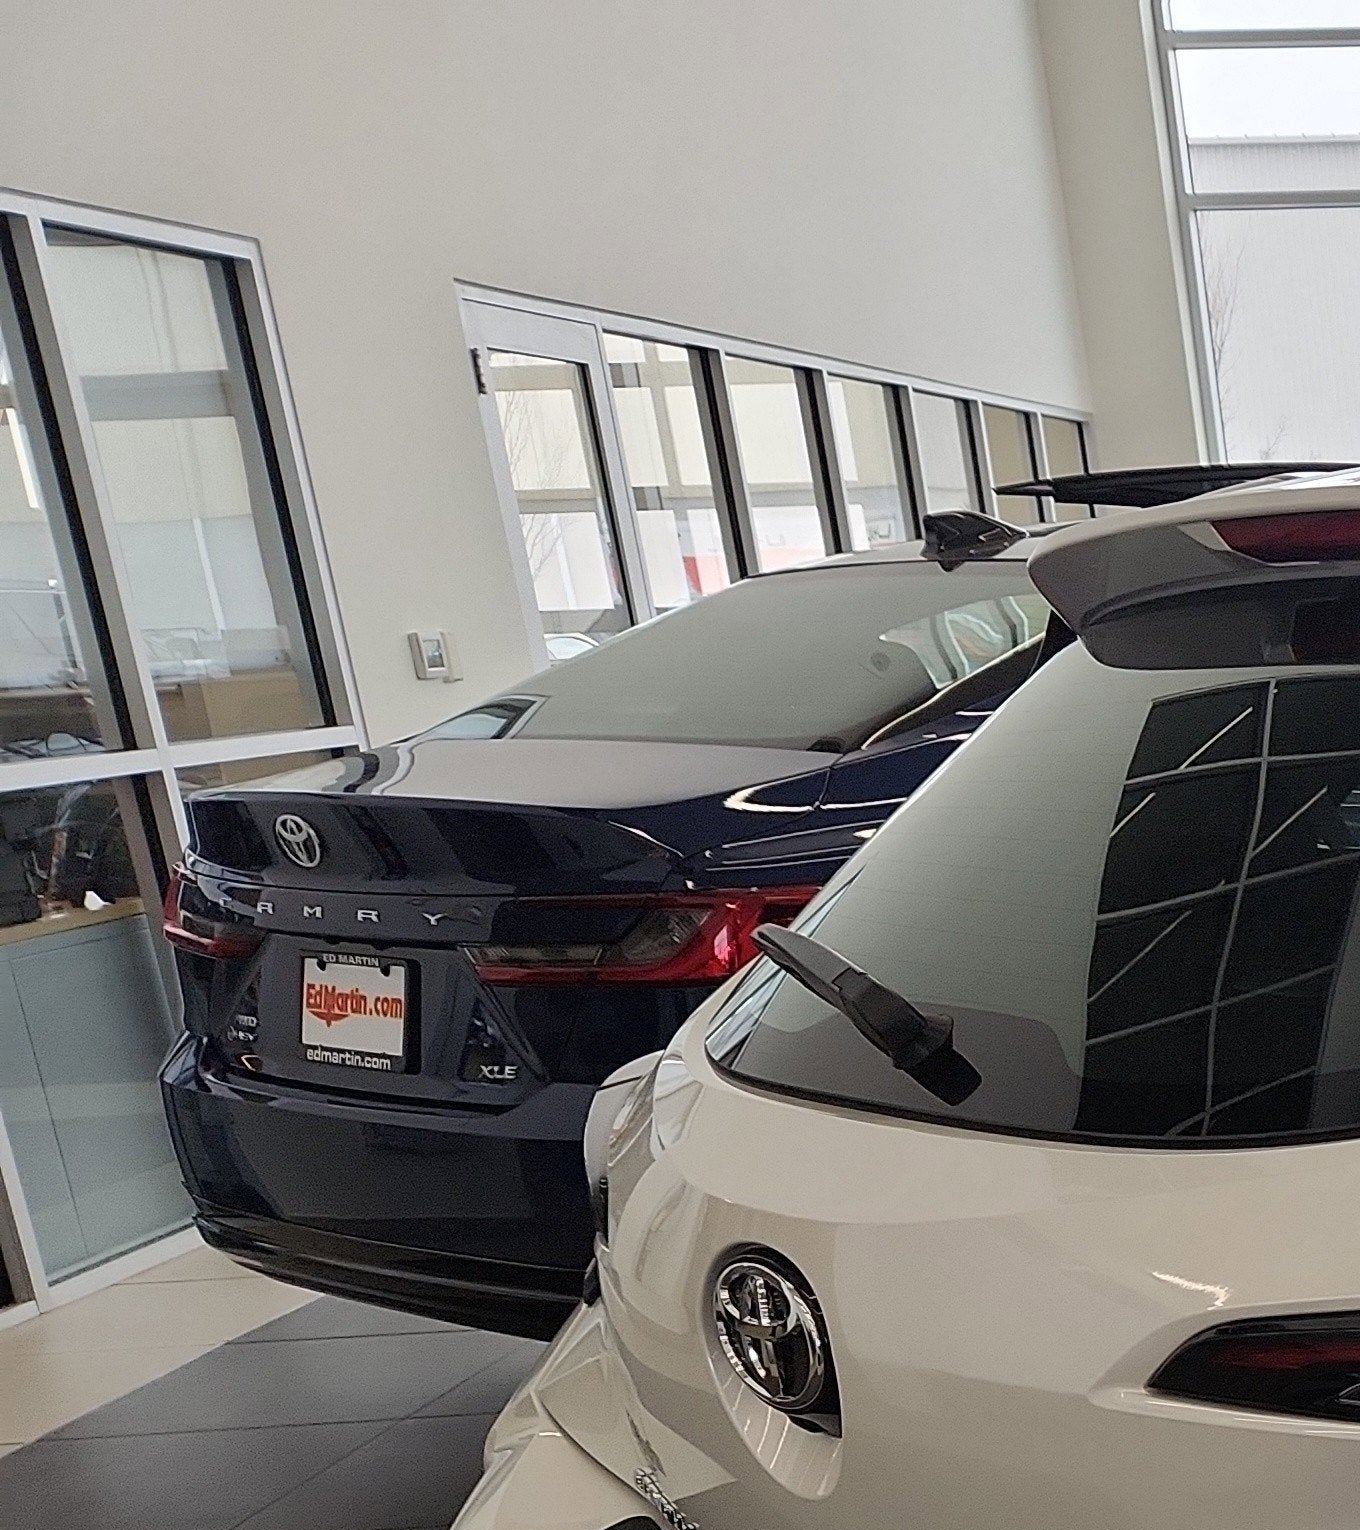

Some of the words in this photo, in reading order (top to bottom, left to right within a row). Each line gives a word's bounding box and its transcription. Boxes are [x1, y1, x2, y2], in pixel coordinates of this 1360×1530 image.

[323, 954, 337, 963] ED
[338, 955, 379, 967] MARTIN
[306, 1047, 391, 1071] edmartin.com
[479, 1065, 518, 1079] XLE
